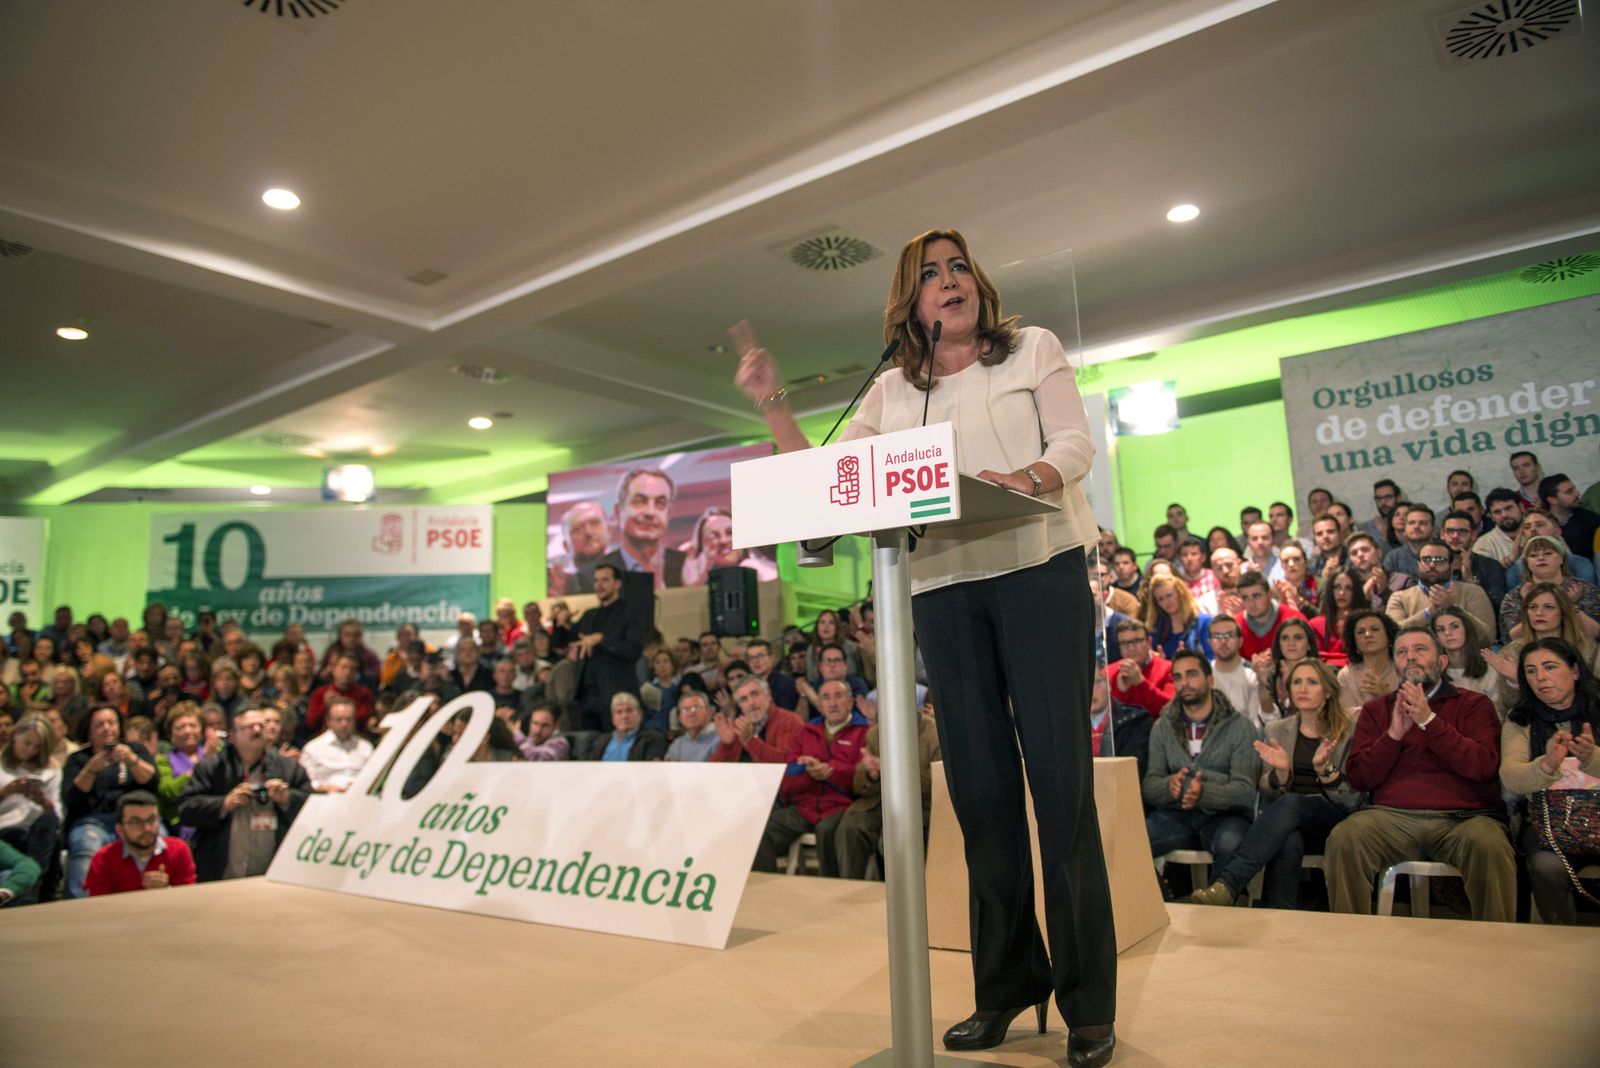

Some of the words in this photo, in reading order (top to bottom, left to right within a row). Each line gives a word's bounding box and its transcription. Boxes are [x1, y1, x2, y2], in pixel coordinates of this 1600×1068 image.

[1313, 363, 1494, 409] Orgullosos
[1316, 415, 1368, 445] de
[1376, 380, 1595, 436] defender
[886, 445, 942, 465] Andalucía
[1321, 444, 1395, 473] una
[1402, 428, 1496, 462] vida
[1504, 411, 1600, 447] dign
[886, 462, 950, 497] PSOE
[163, 520, 266, 590] 10
[427, 529, 482, 548] PSOE
[259, 581, 323, 604] años
[251, 605, 284, 627] de
[288, 600, 462, 629] Dependencia
[350, 690, 495, 802] 10
[418, 793, 508, 834] años
[296, 829, 331, 864] de
[331, 831, 391, 879] Ley
[390, 837, 432, 876] de
[432, 840, 717, 912] Dependencia
